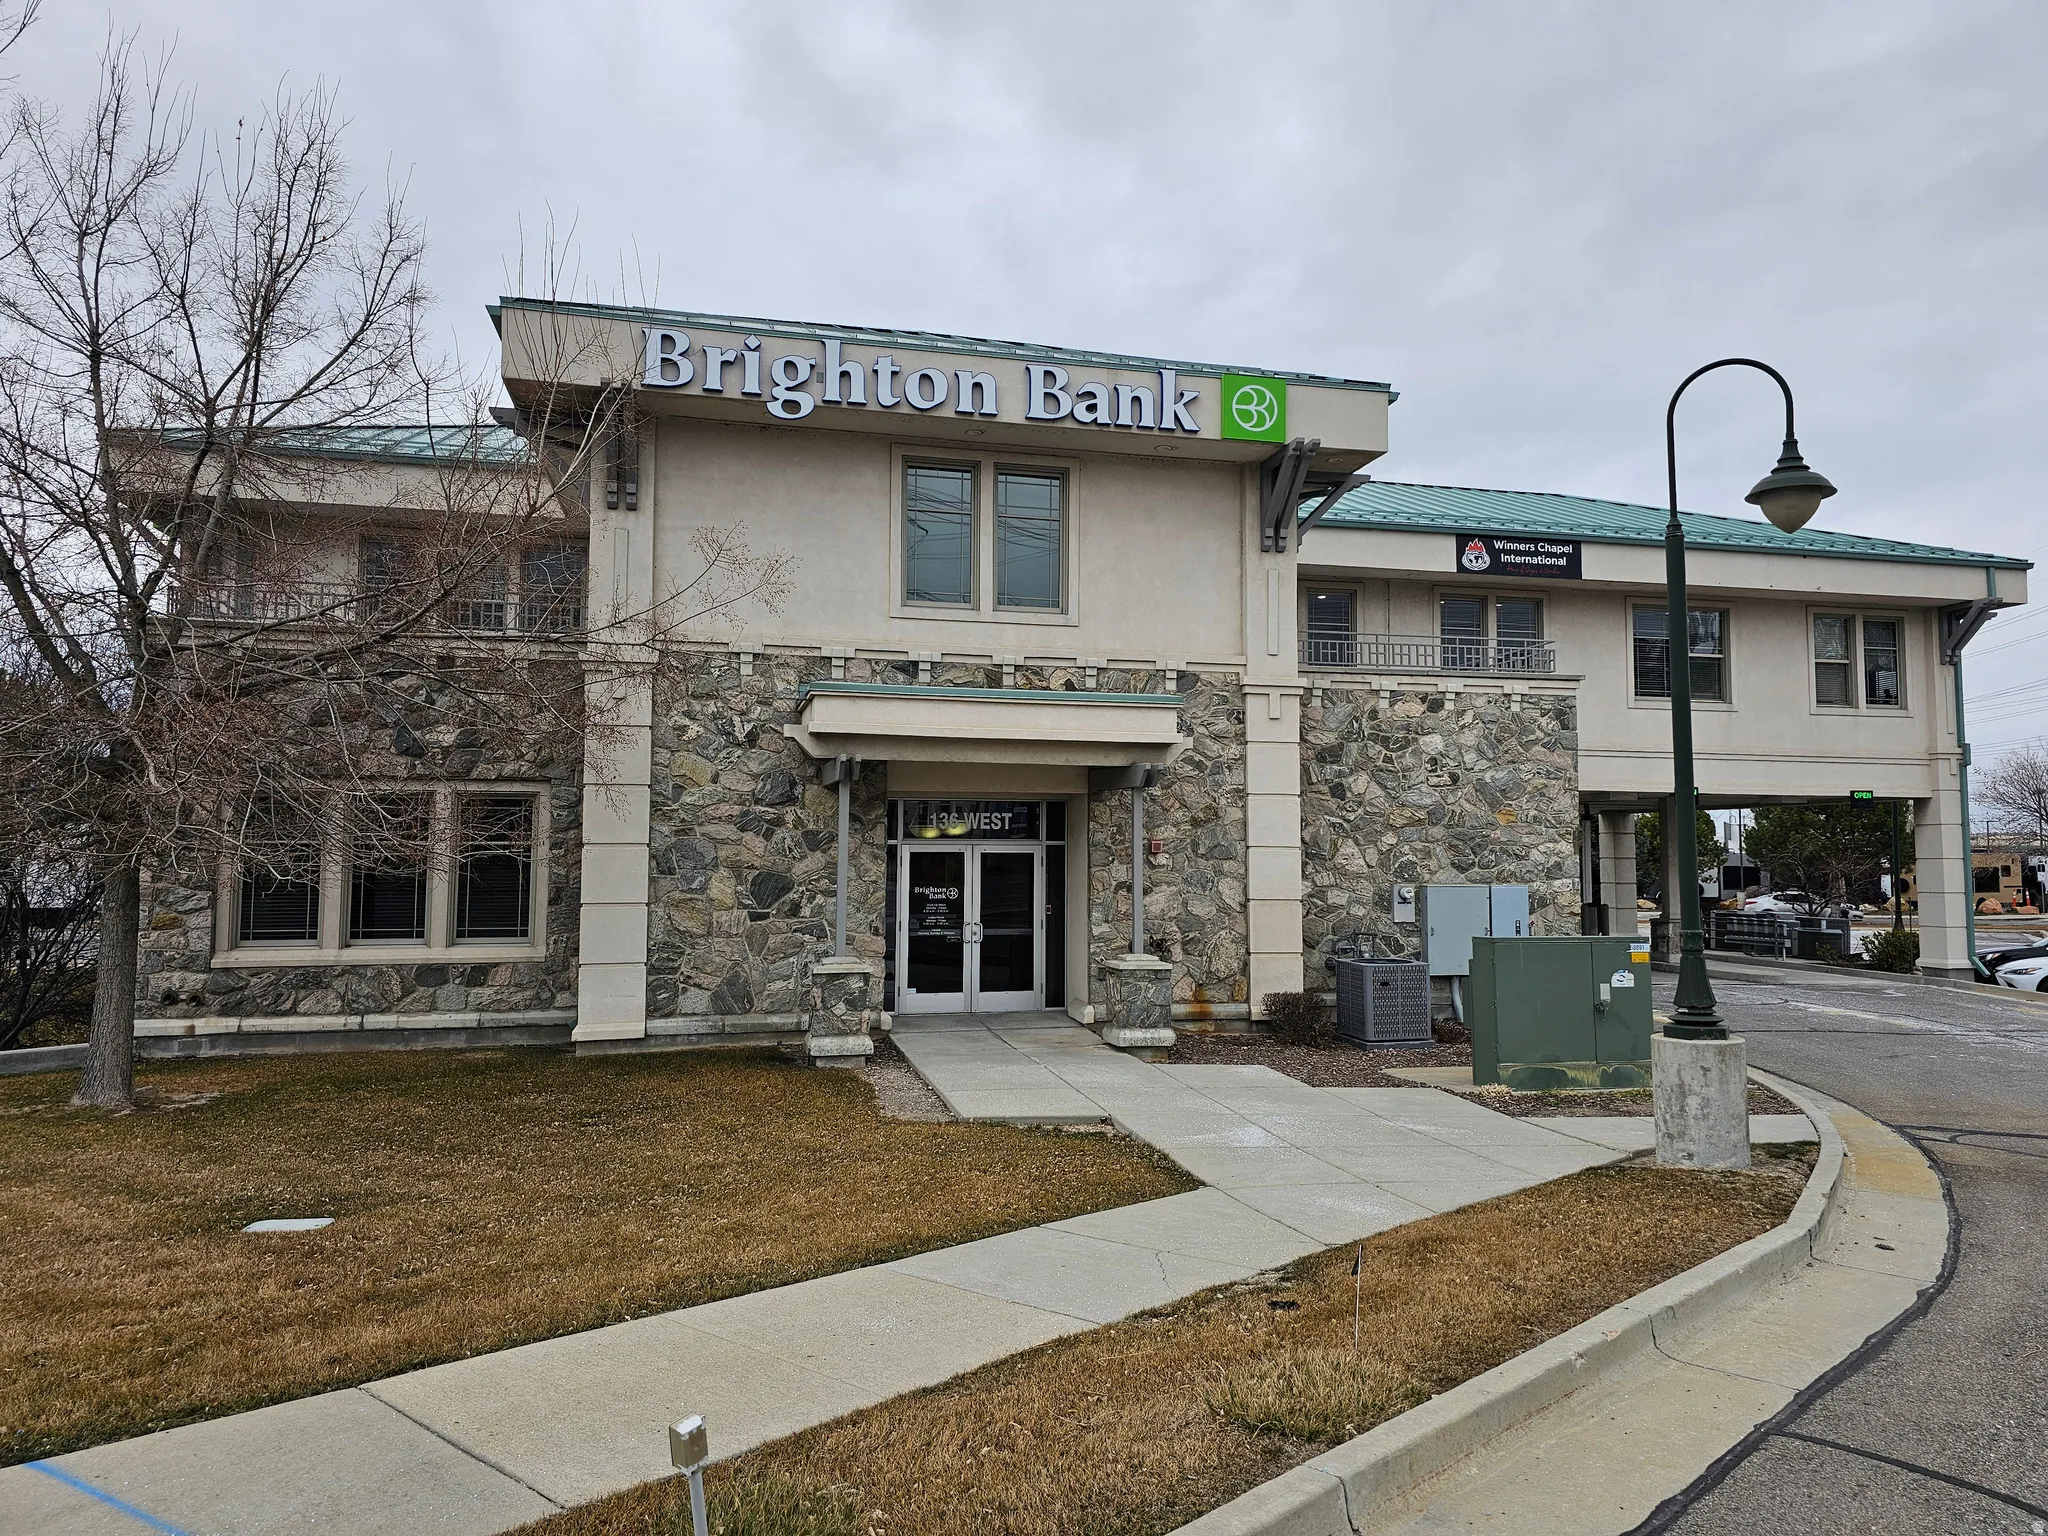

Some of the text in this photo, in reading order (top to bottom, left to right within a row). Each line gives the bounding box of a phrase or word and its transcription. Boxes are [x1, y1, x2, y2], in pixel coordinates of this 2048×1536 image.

[640, 326, 1200, 432] Brighton Bank
[1493, 540, 1573, 554] Winners Chapel
[1501, 553, 1567, 566] International
[930, 812, 1013, 830] 136 WEST
[914, 886, 947, 895] Brighton
